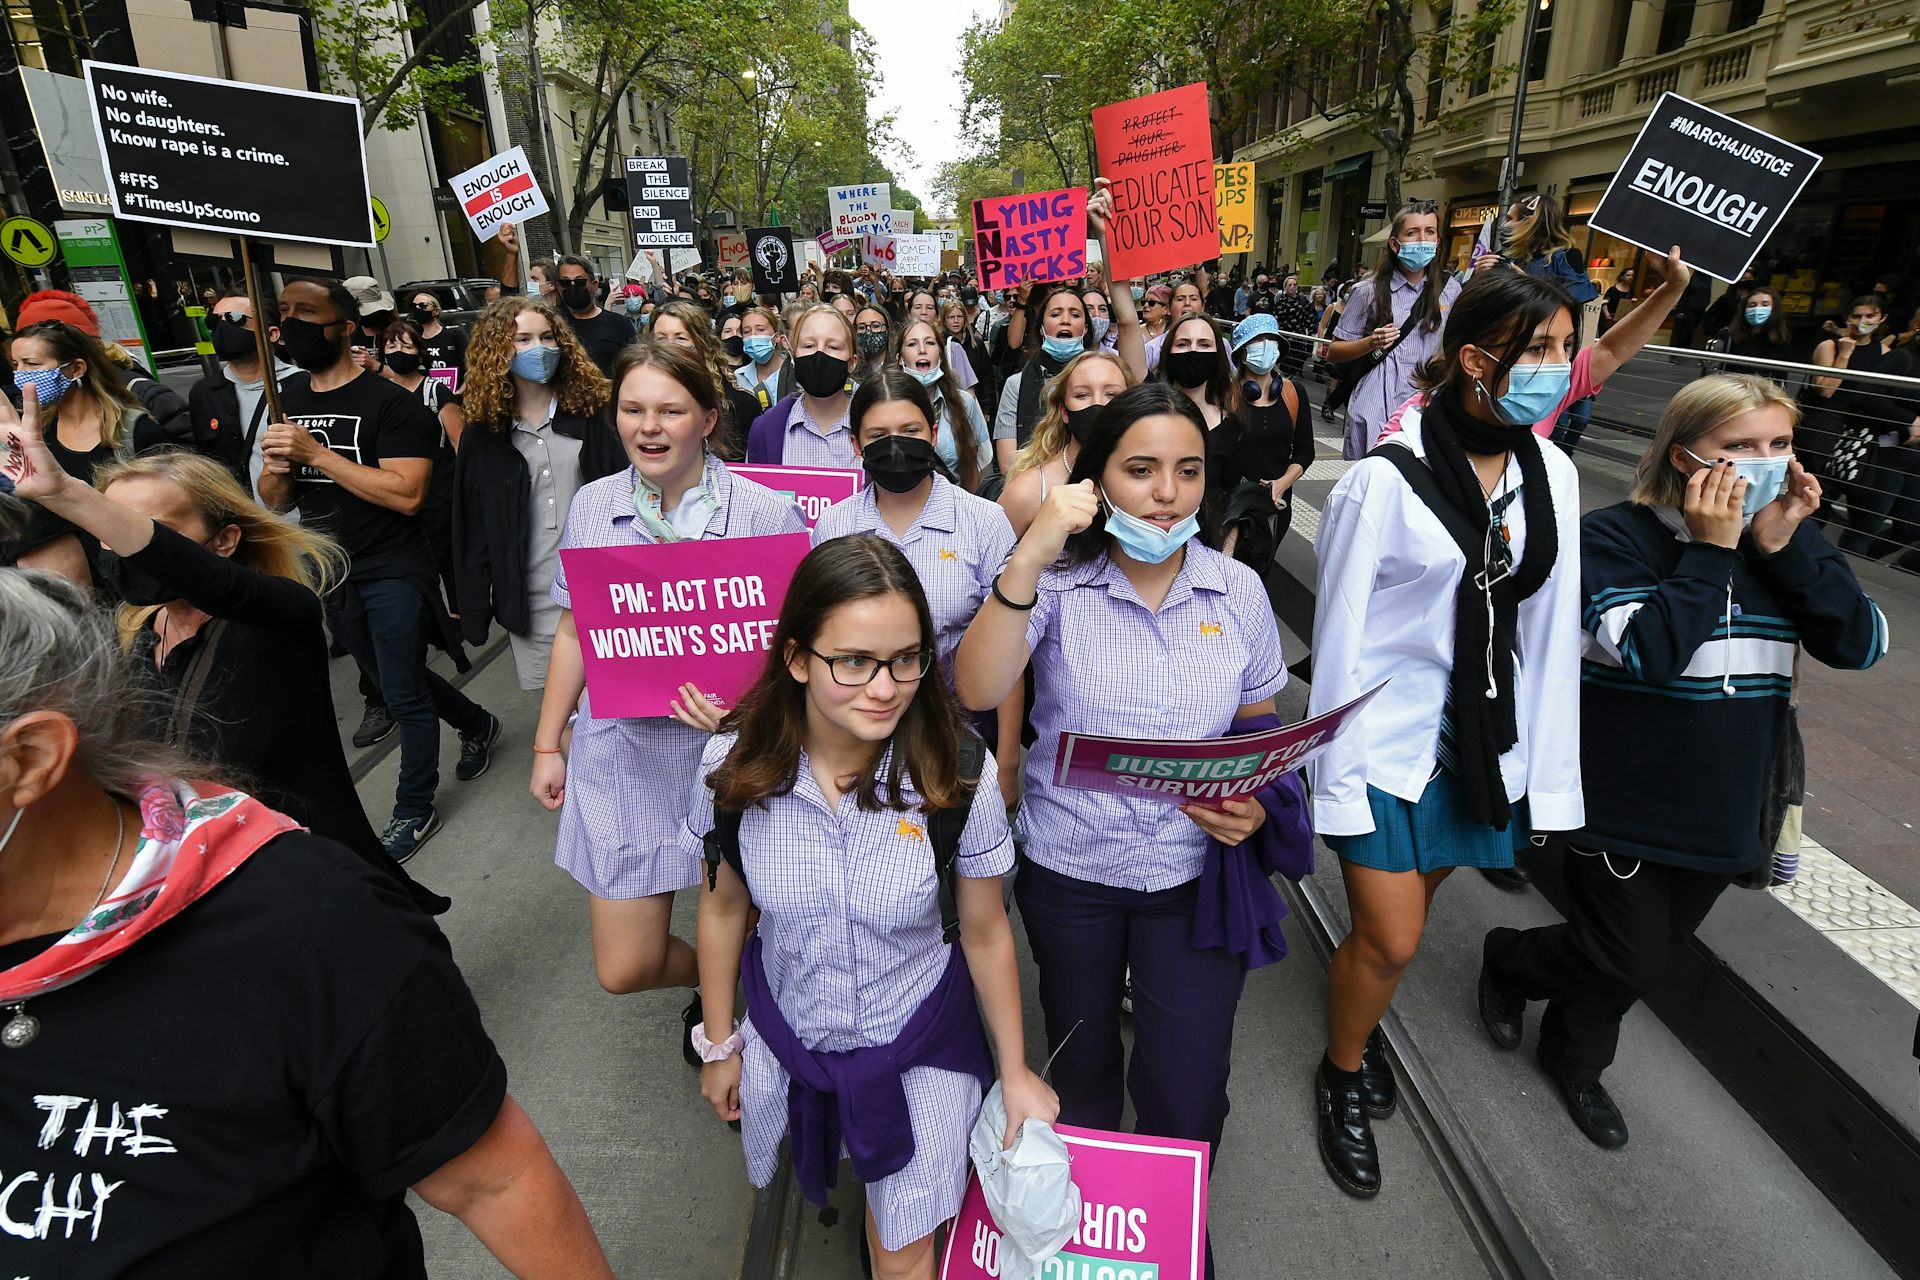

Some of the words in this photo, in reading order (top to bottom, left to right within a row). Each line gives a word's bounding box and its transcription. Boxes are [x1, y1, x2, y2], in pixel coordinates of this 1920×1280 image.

[100, 84, 128, 101] No
[131, 89, 173, 108] wife.
[105, 106, 131, 123] No
[135, 111, 226, 137] daughters.
[1122, 105, 1180, 133] PROTECT
[109, 128, 157, 148] Know
[161, 138, 199, 156] rape
[201, 141, 217, 156] is
[221, 147, 232, 159] a
[236, 147, 290, 166] crime.
[1114, 140, 1184, 166] DAUGHTER
[1129, 129, 1169, 148] YOUR
[1669, 115, 1795, 178] #MARCH4JUSTICE
[463, 159, 521, 198] ENOUGH
[629, 161, 665, 170] BREAK
[647, 175, 669, 184] THE
[119, 171, 159, 190] #FFS
[489, 187, 503, 203] IS
[643, 189, 687, 198] SILENCE
[837, 186, 878, 200] WHERE
[1110, 159, 1210, 213] EDUCATE
[1632, 157, 1769, 233] ENOUGH
[124, 192, 261, 223] #TimesUpScomo
[475, 193, 536, 230] ENOUGH
[635, 208, 658, 217] END
[839, 212, 877, 225] BLOODY
[848, 202, 869, 212] THE
[973, 193, 1074, 230] LYING
[638, 234, 692, 243] VIOLENCE
[653, 221, 675, 230] THE
[836, 226, 854, 235] HELL
[855, 224, 869, 234] ARE
[1107, 208, 1165, 252] YOUR
[1168, 196, 1215, 243] SON
[976, 224, 1070, 260] NASTY
[979, 249, 1084, 290] PRICKS
[297, 418, 336, 428] PEOPLE
[608, 582, 656, 615] PM:
[661, 578, 707, 613] ACT
[713, 575, 767, 610] FOR
[588, 624, 707, 660] WOMEN'S
[1111, 754, 1259, 779] JUSTICE
[1261, 729, 1327, 770] FOR
[33, 1094, 179, 1158] THE
[0, 1169, 127, 1242] CHY
